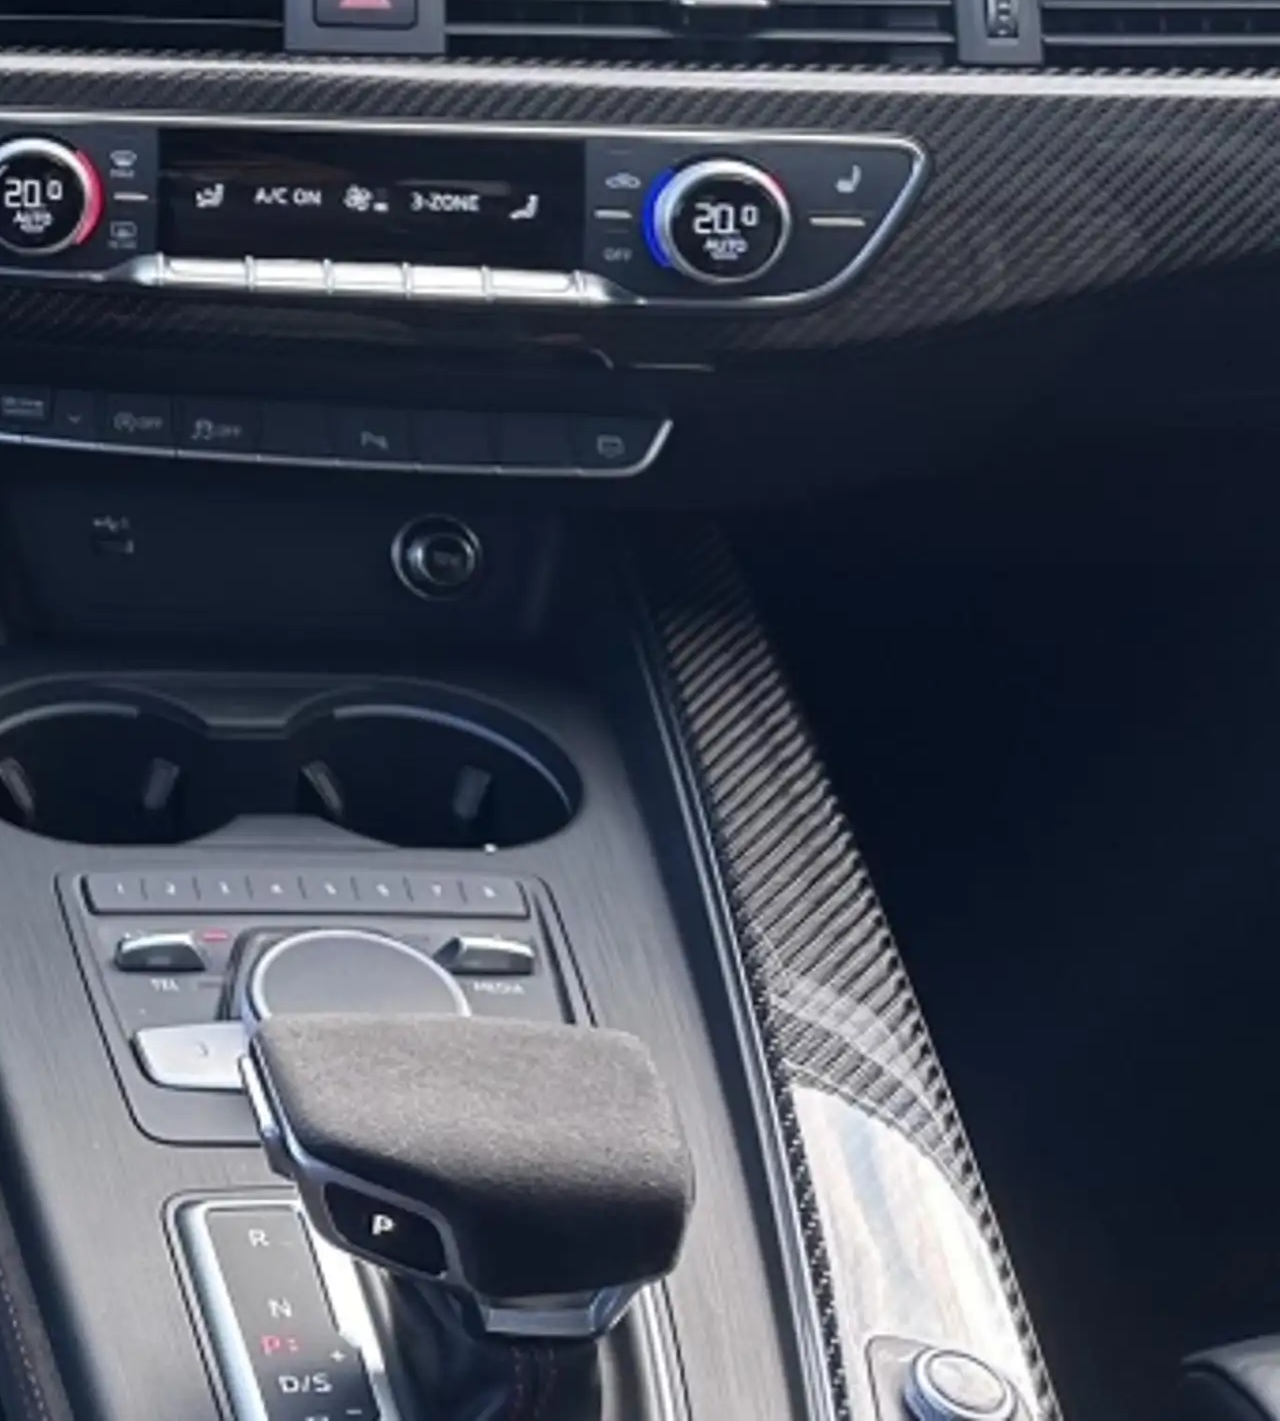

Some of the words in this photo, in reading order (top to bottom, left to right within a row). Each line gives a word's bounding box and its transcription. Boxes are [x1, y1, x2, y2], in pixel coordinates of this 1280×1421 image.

[254, 187, 287, 204] A/C
[293, 188, 322, 205] ON
[410, 192, 480, 212] 3-ZONE
[371, 1214, 396, 1236] P
[248, 1229, 270, 1247] R
[267, 1297, 293, 1318] N
[262, 1335, 280, 1355] P
[278, 1372, 333, 1394] D/S
